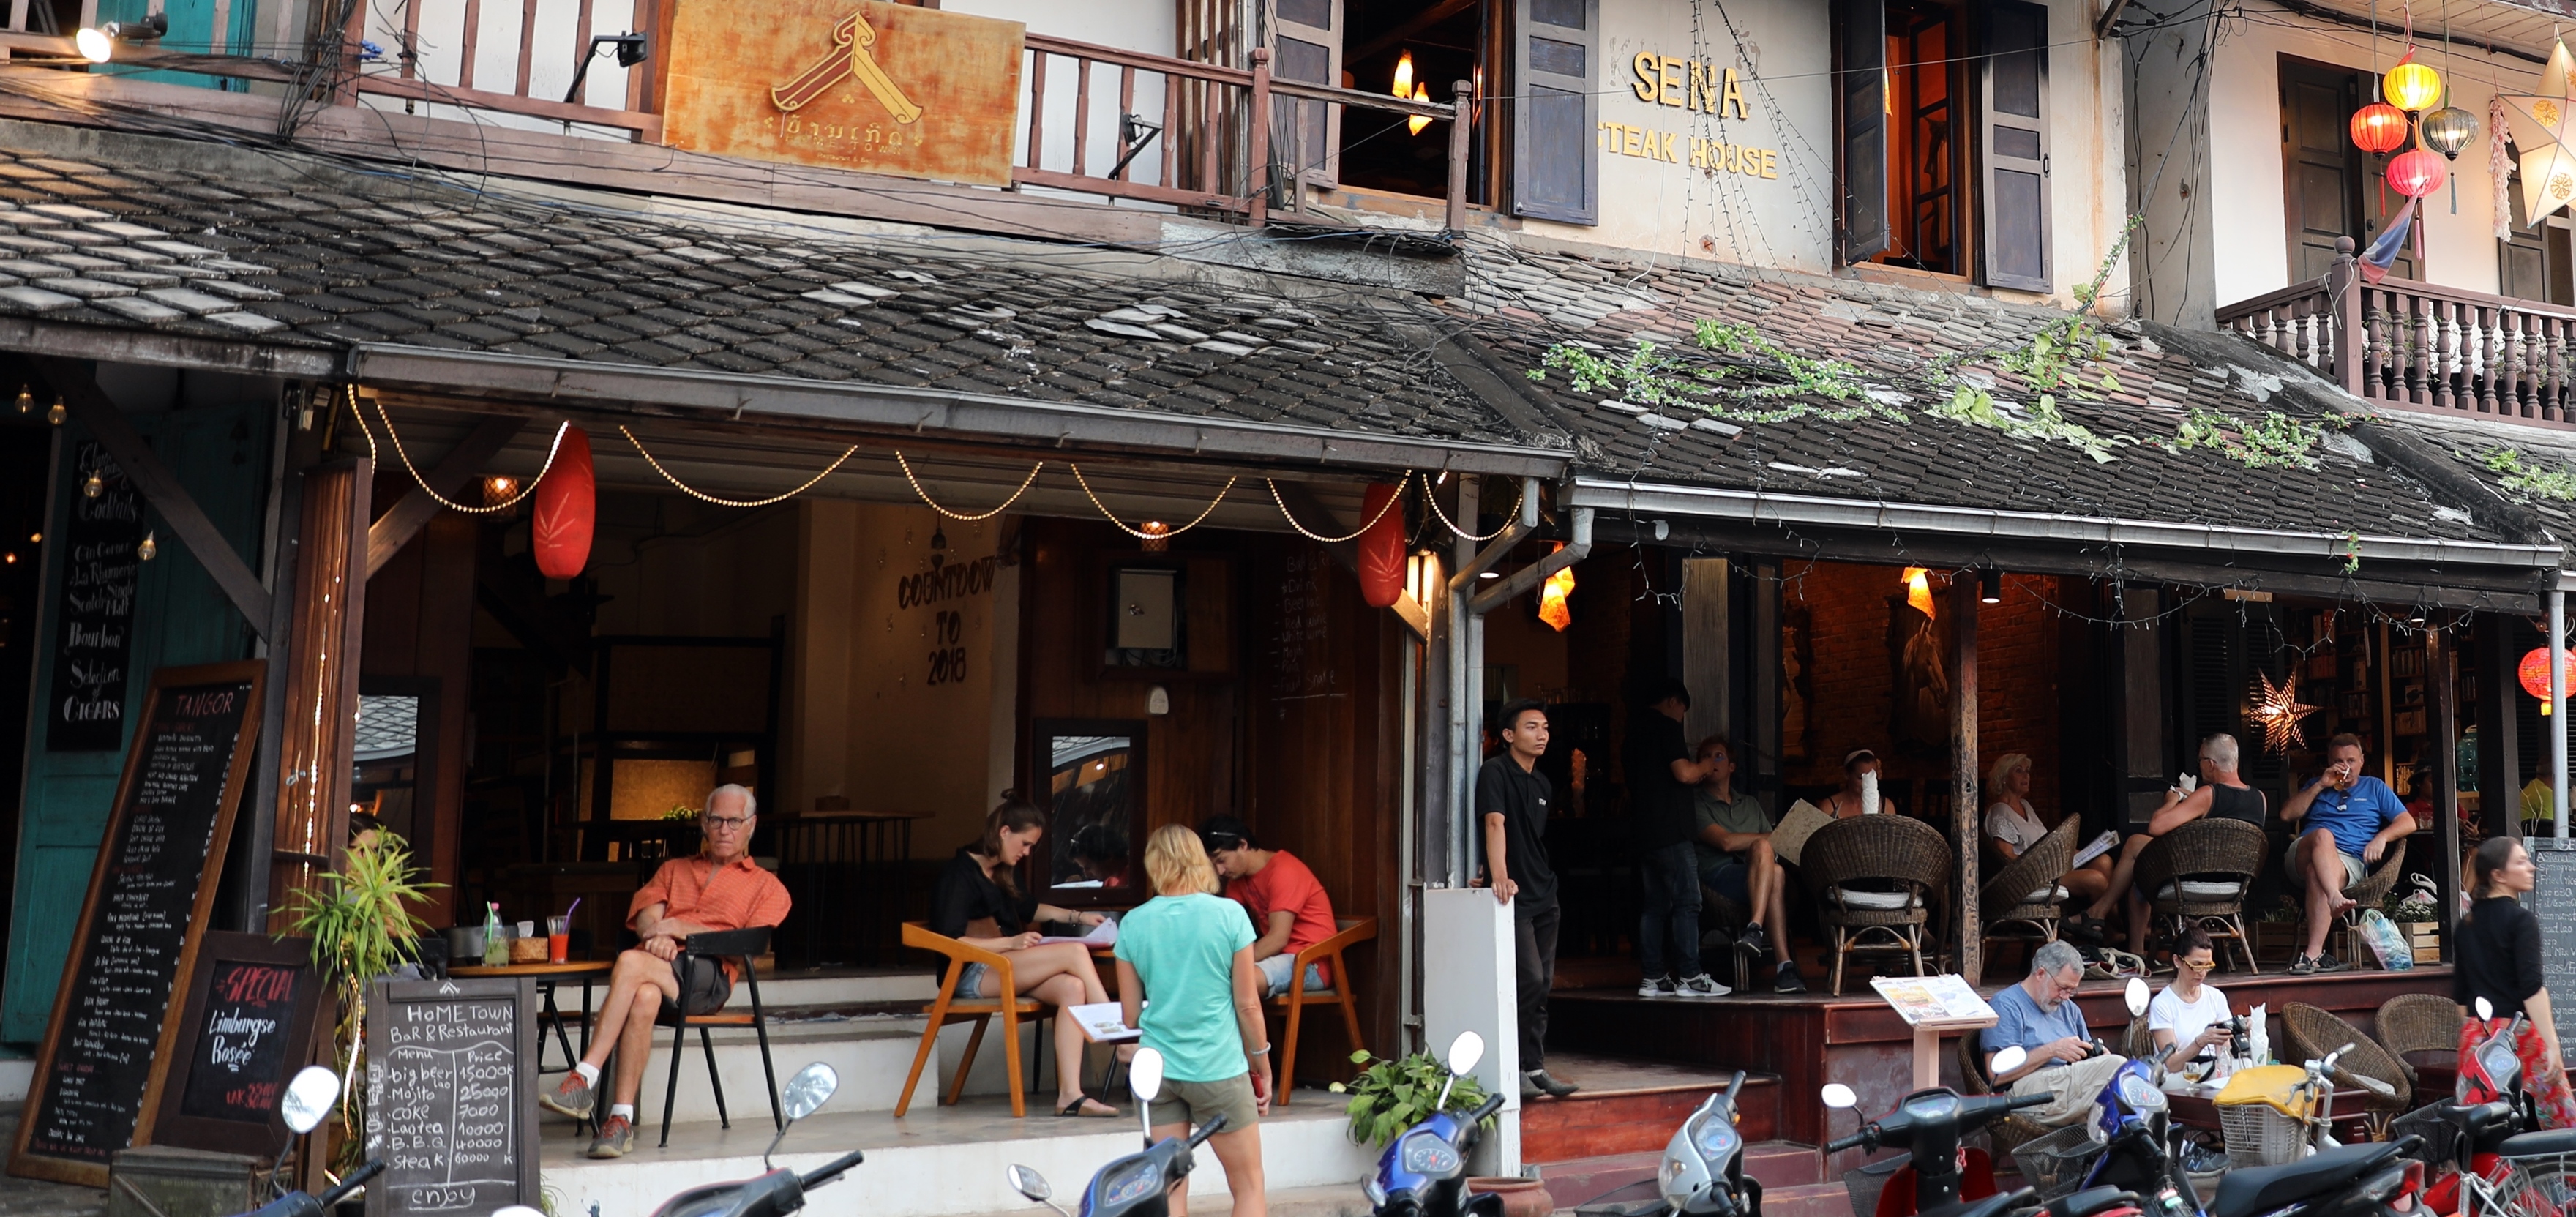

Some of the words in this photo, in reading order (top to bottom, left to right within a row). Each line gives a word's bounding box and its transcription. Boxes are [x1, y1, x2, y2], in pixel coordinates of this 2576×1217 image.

[1632, 50, 1748, 119] SENA
[850, 141, 902, 155] TOWN
[1689, 136, 1778, 180] HOUSE
[68, 621, 121, 649] Bourbon
[936, 610, 961, 645] TO
[70, 658, 121, 689] Selection
[927, 647, 966, 685] 2018
[176, 691, 233, 717] TANGOR
[2558, 838, 2576, 851] SE
[225, 966, 295, 1003] SPECIAL
[209, 1006, 277, 1047] Limburgse
[425, 1023, 437, 1042] &
[438, 1021, 514, 1041] Restaurant
[397, 1049, 434, 1060] Menu
[468, 1050, 503, 1063] Price
[390, 1066, 418, 1087] big
[421, 1063, 453, 1081] beer
[433, 1079, 451, 1089] lao
[392, 1085, 435, 1107] Mojito
[458, 1104, 499, 1120] 7000
[458, 1121, 504, 1136] 10000
[455, 1138, 503, 1150] 40000
[455, 1151, 489, 1164] 60000
[411, 1186, 476, 1209] enjoy
